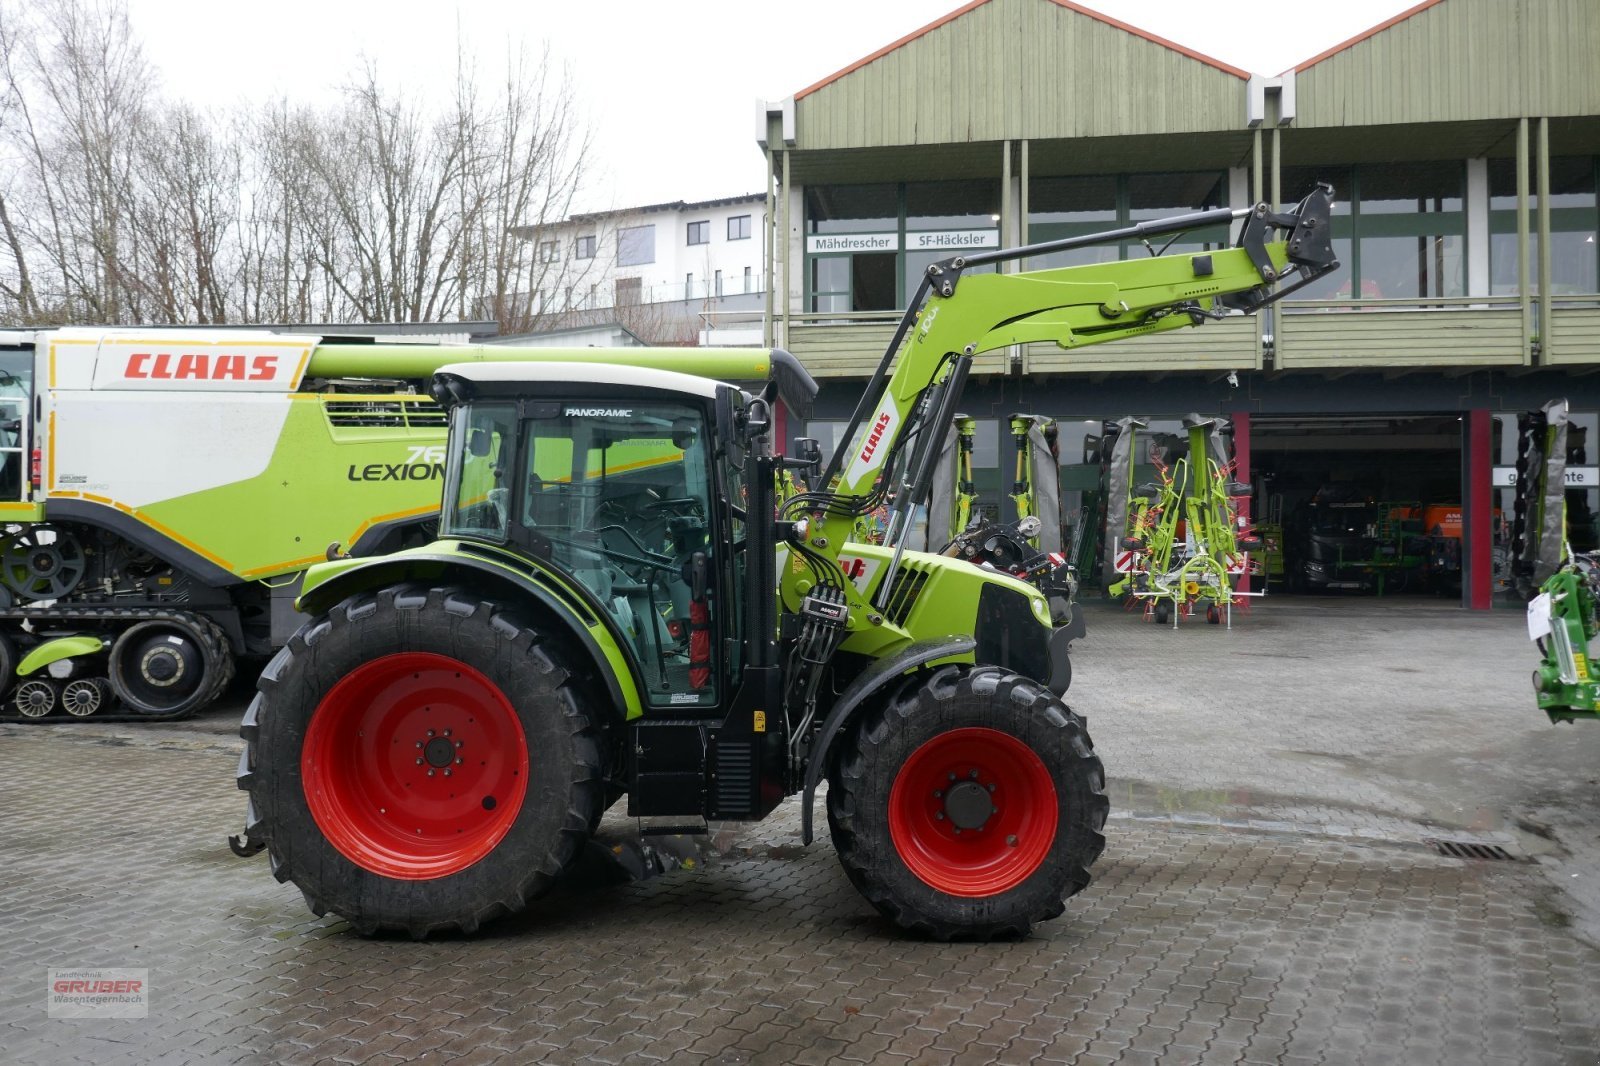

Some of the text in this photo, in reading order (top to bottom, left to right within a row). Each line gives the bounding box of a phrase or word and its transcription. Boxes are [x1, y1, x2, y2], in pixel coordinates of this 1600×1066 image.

[816, 237, 890, 249] Mähdrescher
[919, 234, 985, 246] SF-Häcksler
[124, 354, 278, 380] CLAAS
[565, 408, 632, 417] PANORAMIC
[861, 413, 890, 463] CLAAS
